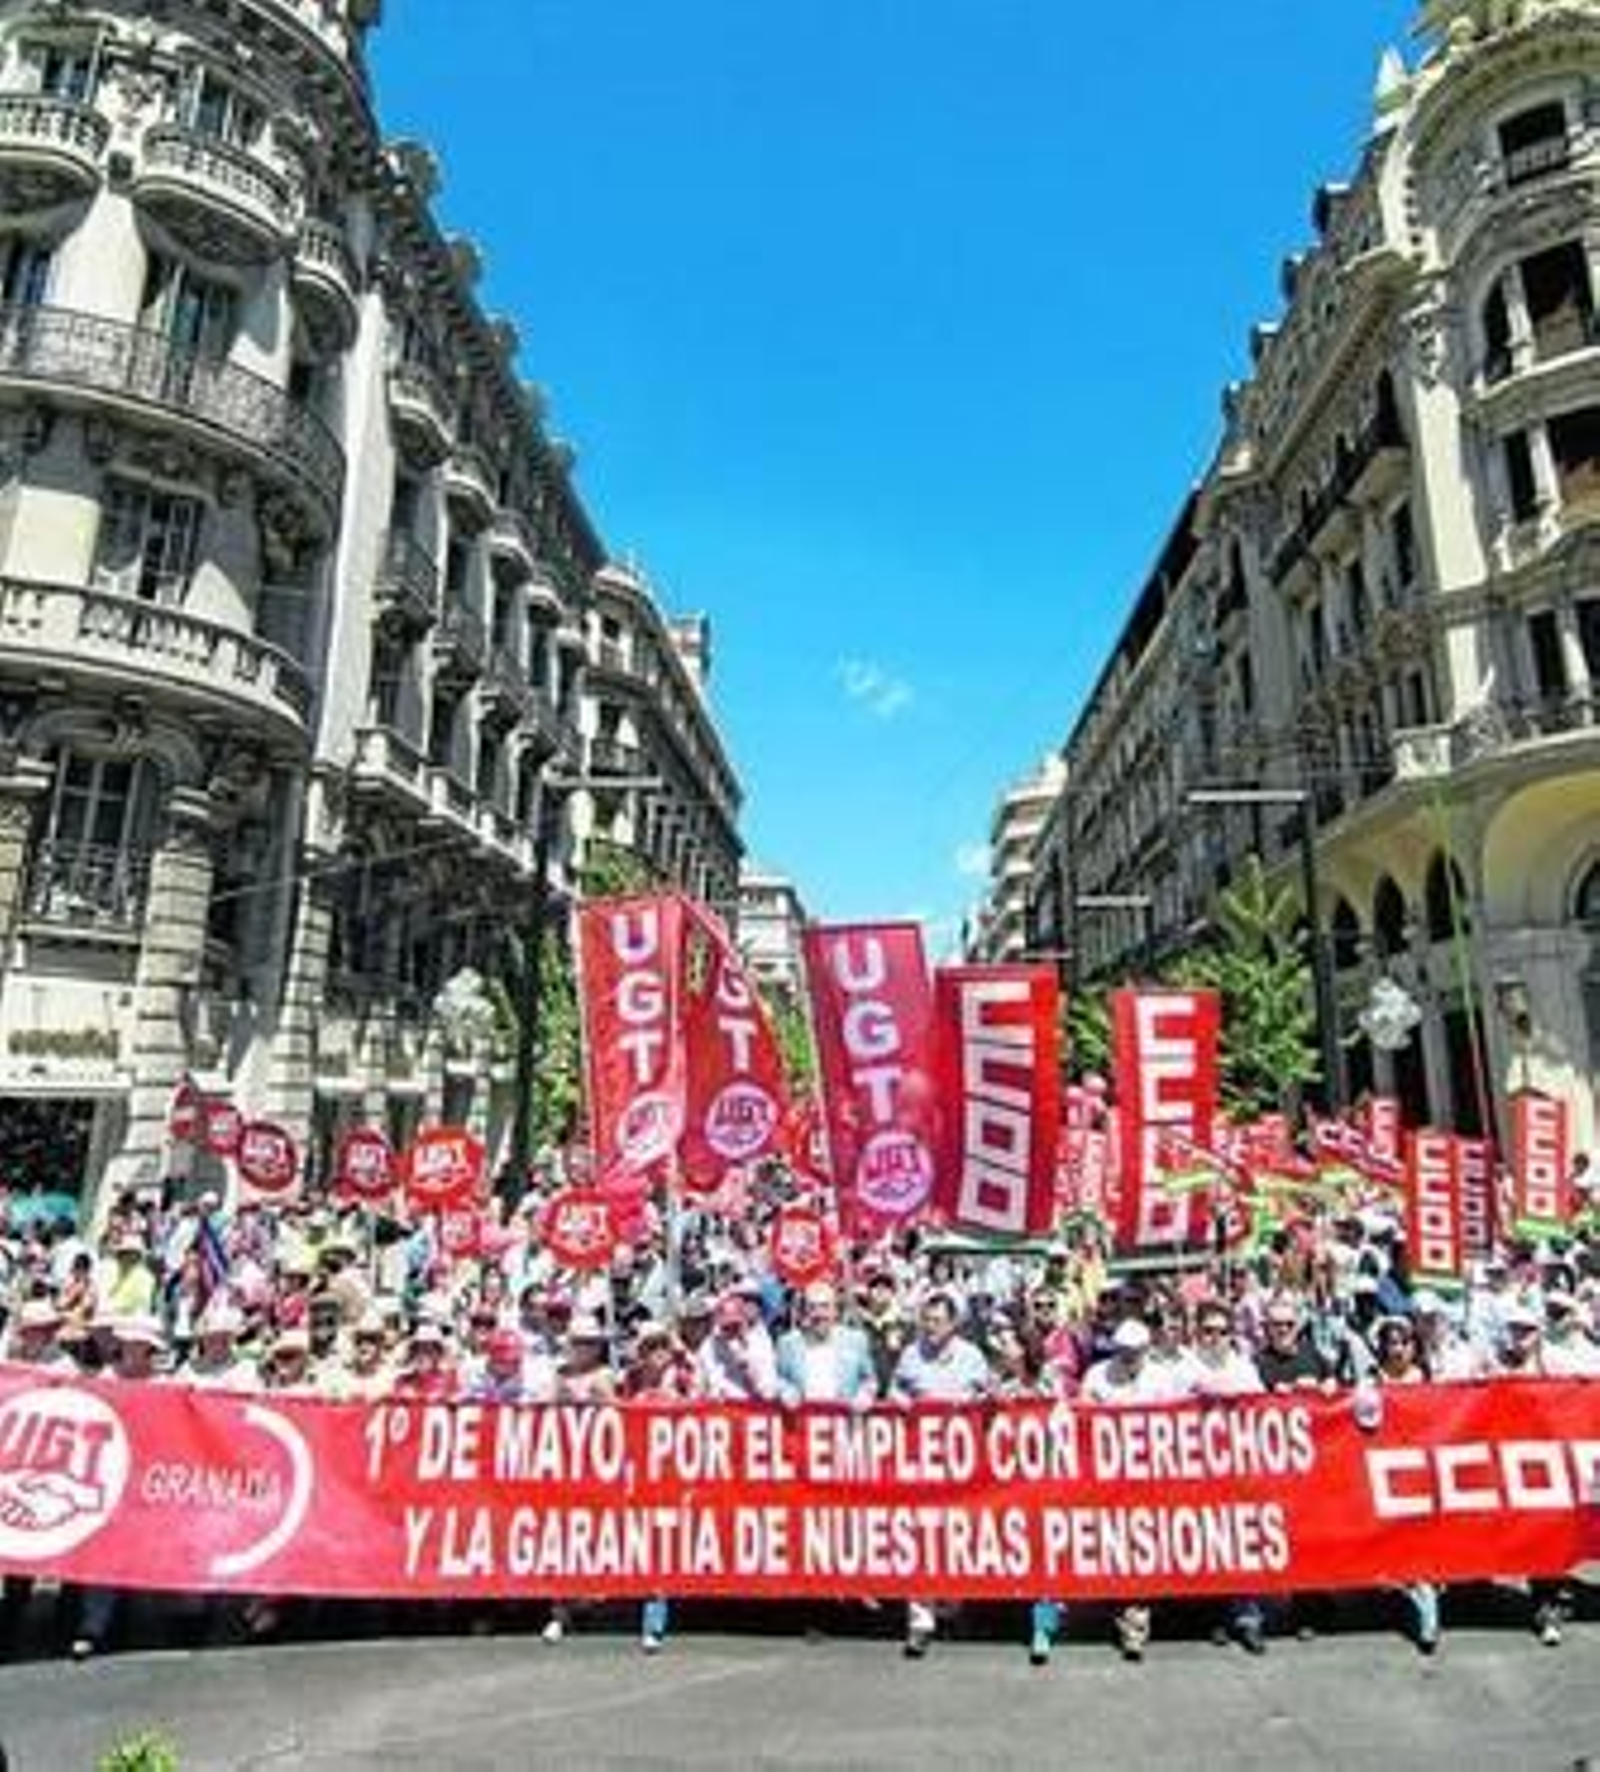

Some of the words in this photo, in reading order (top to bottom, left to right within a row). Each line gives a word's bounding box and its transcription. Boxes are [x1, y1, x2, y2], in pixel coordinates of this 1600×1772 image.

[611, 911, 663, 1084] UGT
[717, 962, 758, 1071] GT
[834, 938, 901, 1123] UGT
[714, 1095, 768, 1126] UGT
[956, 981, 1033, 1232] CCOO
[1526, 1102, 1557, 1217] CCOO
[868, 1145, 918, 1180] UGT
[1416, 1138, 1452, 1269] CCOO
[1459, 1141, 1486, 1248] CCOO
[142, 1462, 281, 1511] GRANADA
[366, 1409, 410, 1478] 1º
[417, 1406, 475, 1478] DE
[497, 1407, 636, 1492] MAYO,
[648, 1416, 731, 1480] POR
[745, 1415, 794, 1480] EL
[809, 1416, 974, 1481] EMPLEO
[989, 1413, 1077, 1480] CON
[1093, 1408, 1313, 1480] DERECHOS
[404, 1509, 434, 1575] Y
[440, 1509, 494, 1575] LA
[509, 1492, 722, 1576] GARANTÍA
[735, 1509, 790, 1576] DE
[804, 1507, 1032, 1576] NUESTRAS
[1044, 1503, 1289, 1576] PENSIONES
